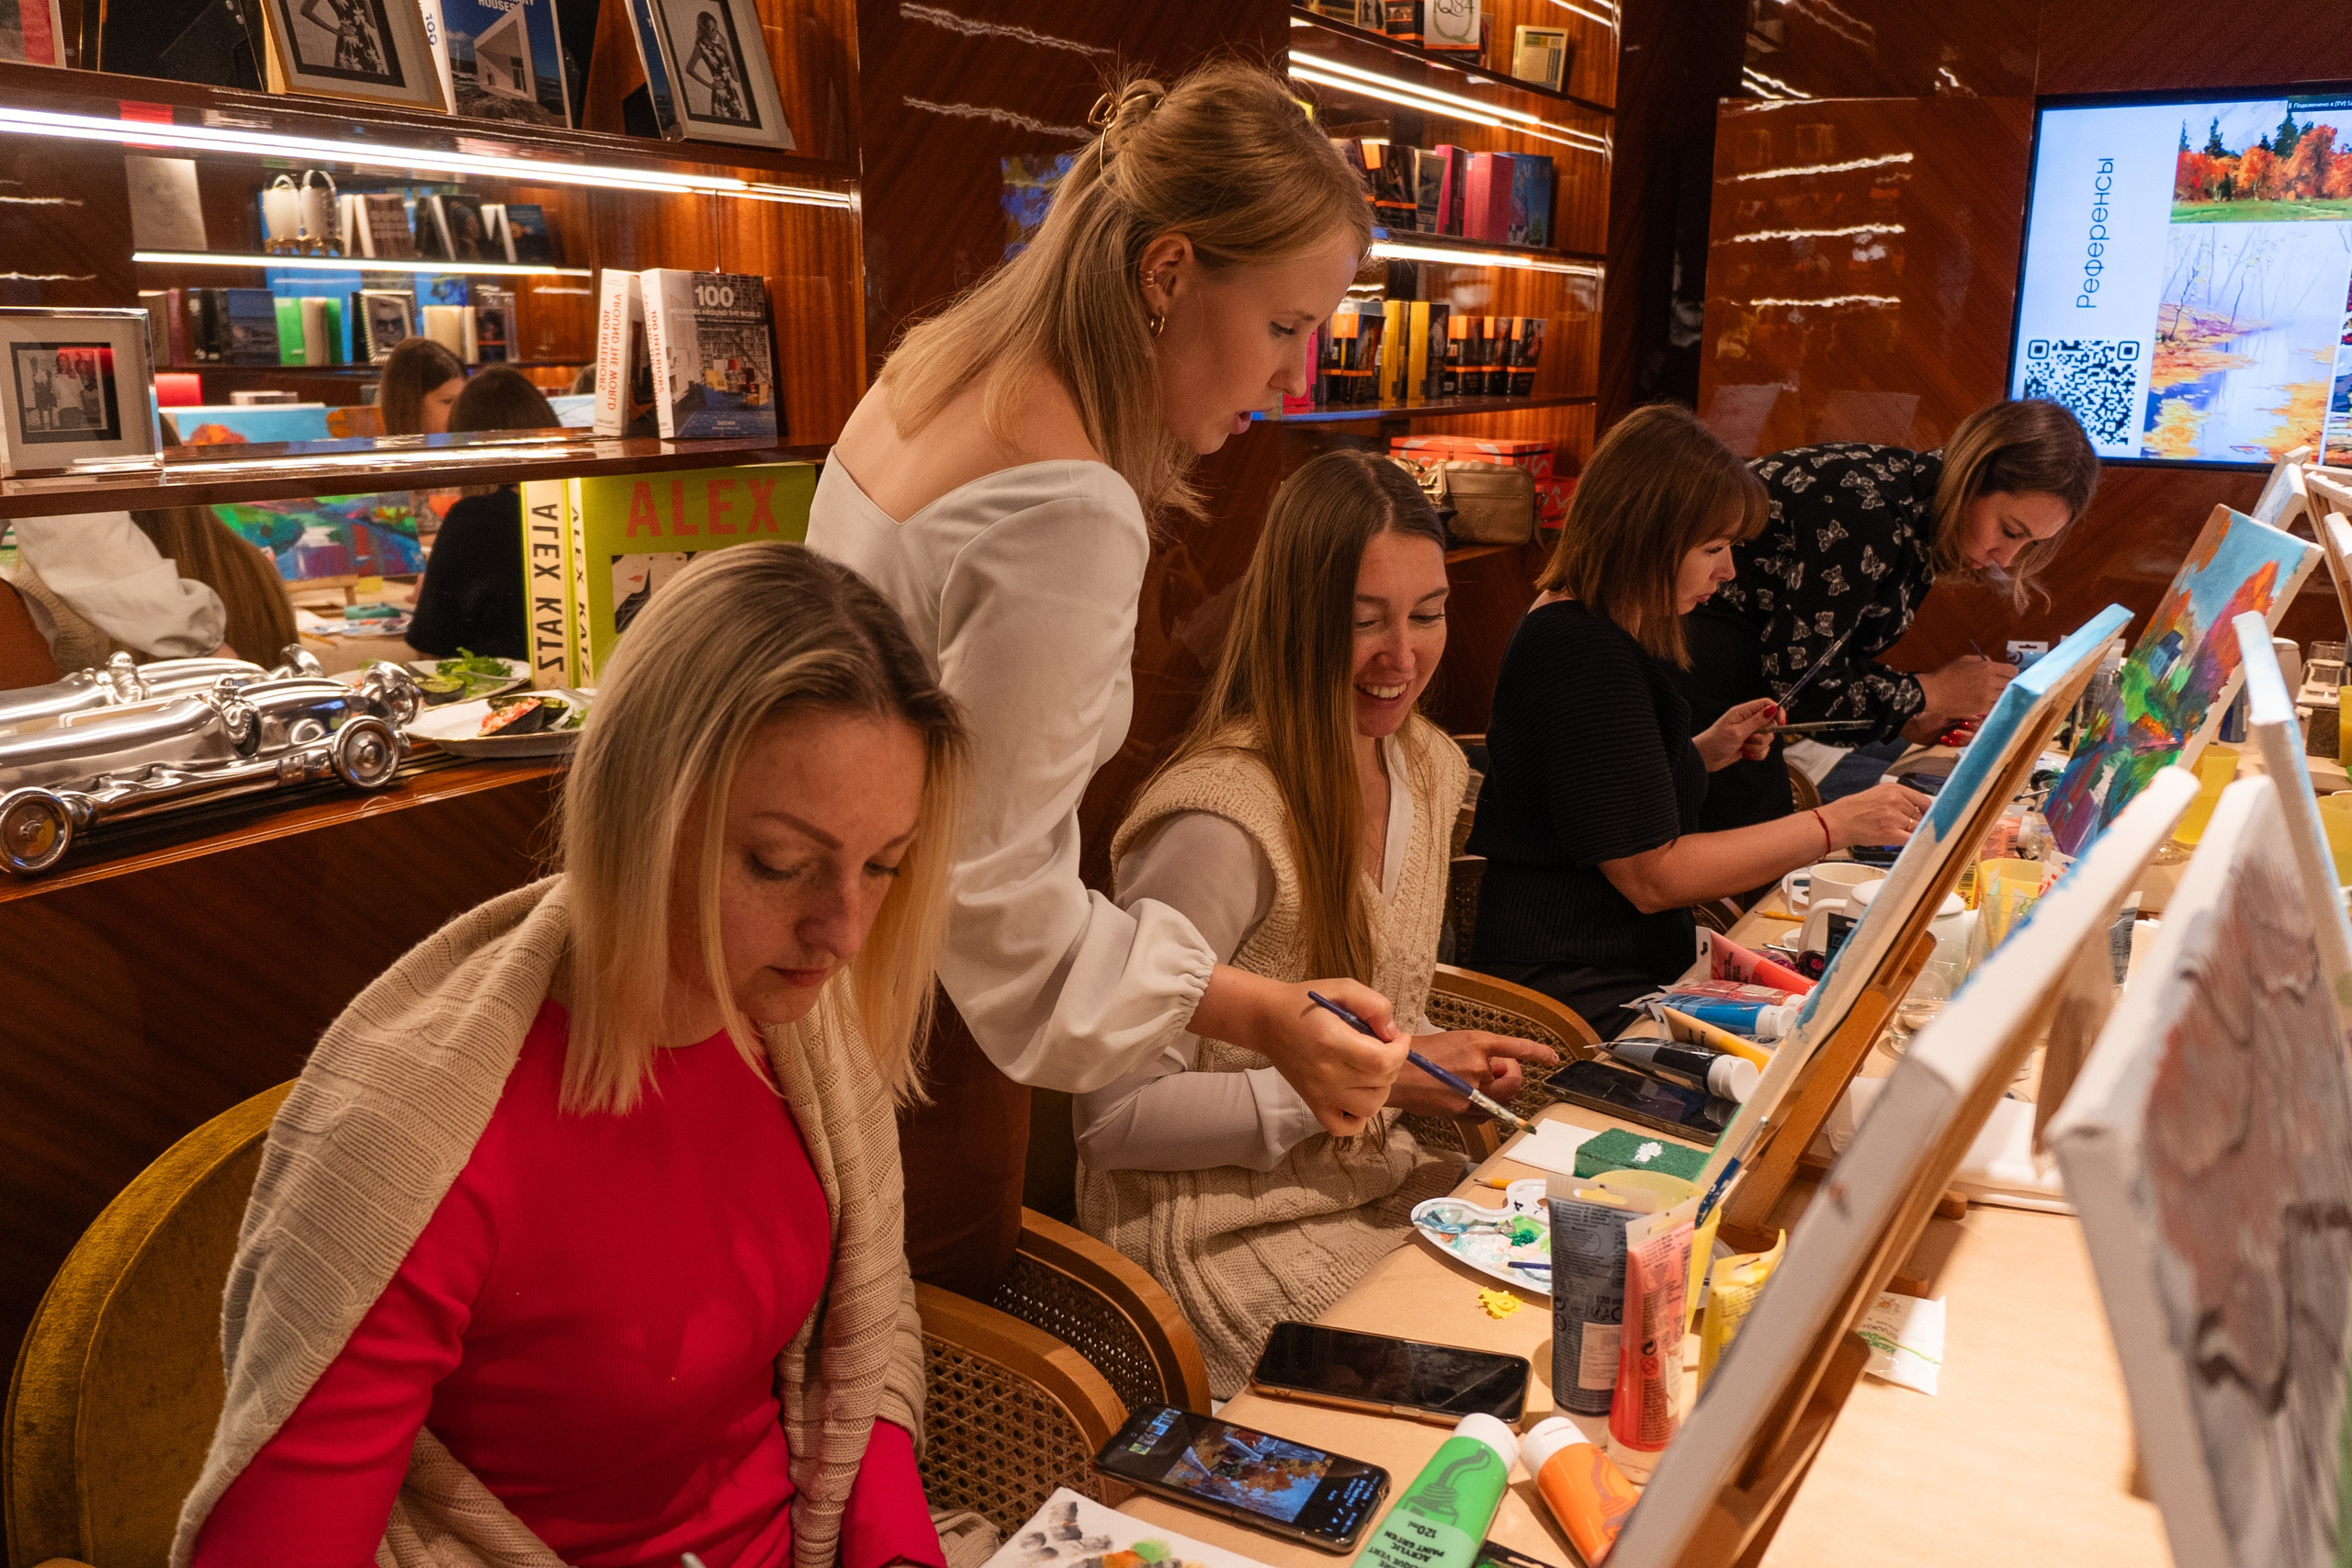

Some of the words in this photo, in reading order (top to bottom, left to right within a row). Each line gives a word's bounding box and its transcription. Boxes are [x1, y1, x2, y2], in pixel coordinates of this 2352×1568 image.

[2076, 157, 2114, 309] Референсы
[695, 286, 735, 308] 100
[651, 309, 660, 331] 100
[653, 333, 665, 393] INTERIORS
[626, 478, 779, 538] ALEX
[571, 505, 585, 583] ALEX
[577, 602, 591, 681] KATZ
[1408, 1520, 1437, 1539] 120ml
[1368, 1545, 1390, 1561] VERT
[1390, 1541, 1431, 1562] ACRYLIC
[1414, 1543, 1445, 1558] PAINT
